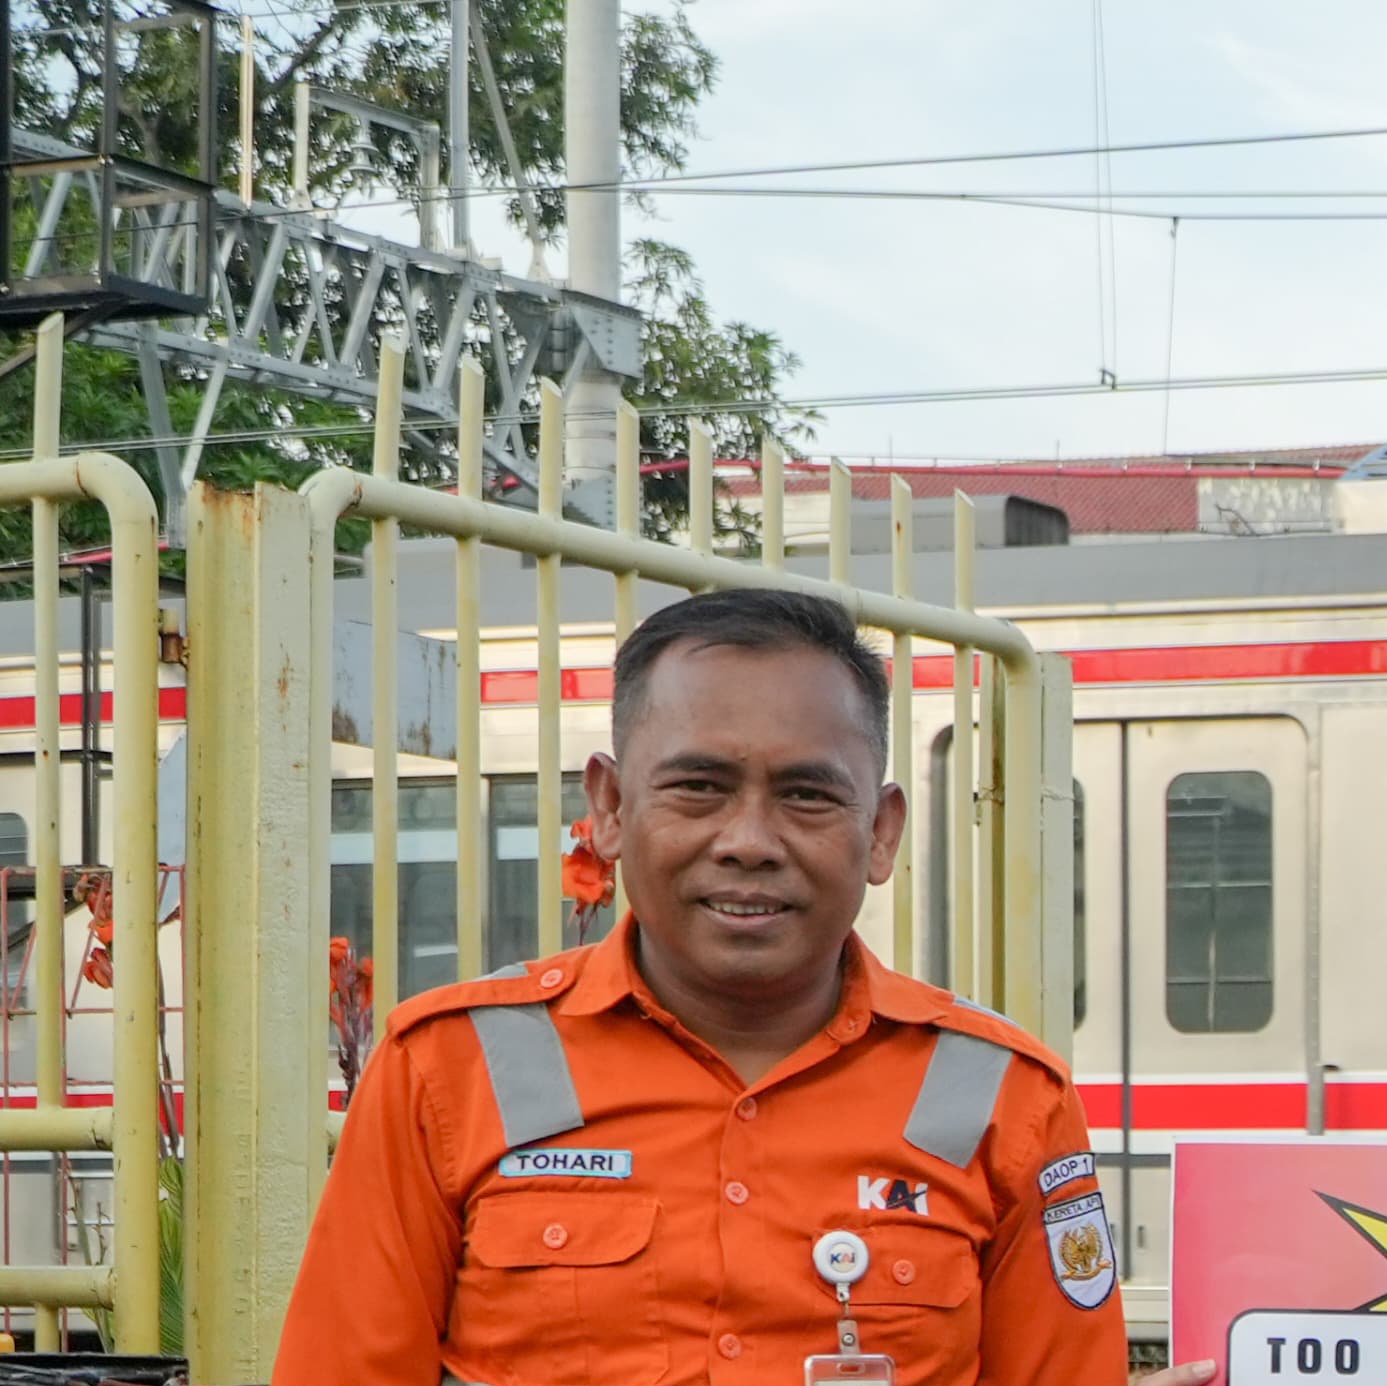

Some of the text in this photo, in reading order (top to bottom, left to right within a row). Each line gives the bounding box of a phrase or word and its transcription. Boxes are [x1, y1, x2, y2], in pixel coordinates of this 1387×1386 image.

[516, 1154, 613, 1171] TOHARI
[1044, 1159, 1079, 1187] DAOP
[857, 1175, 929, 1216] KAI
[1268, 1338, 1360, 1376] TOO
